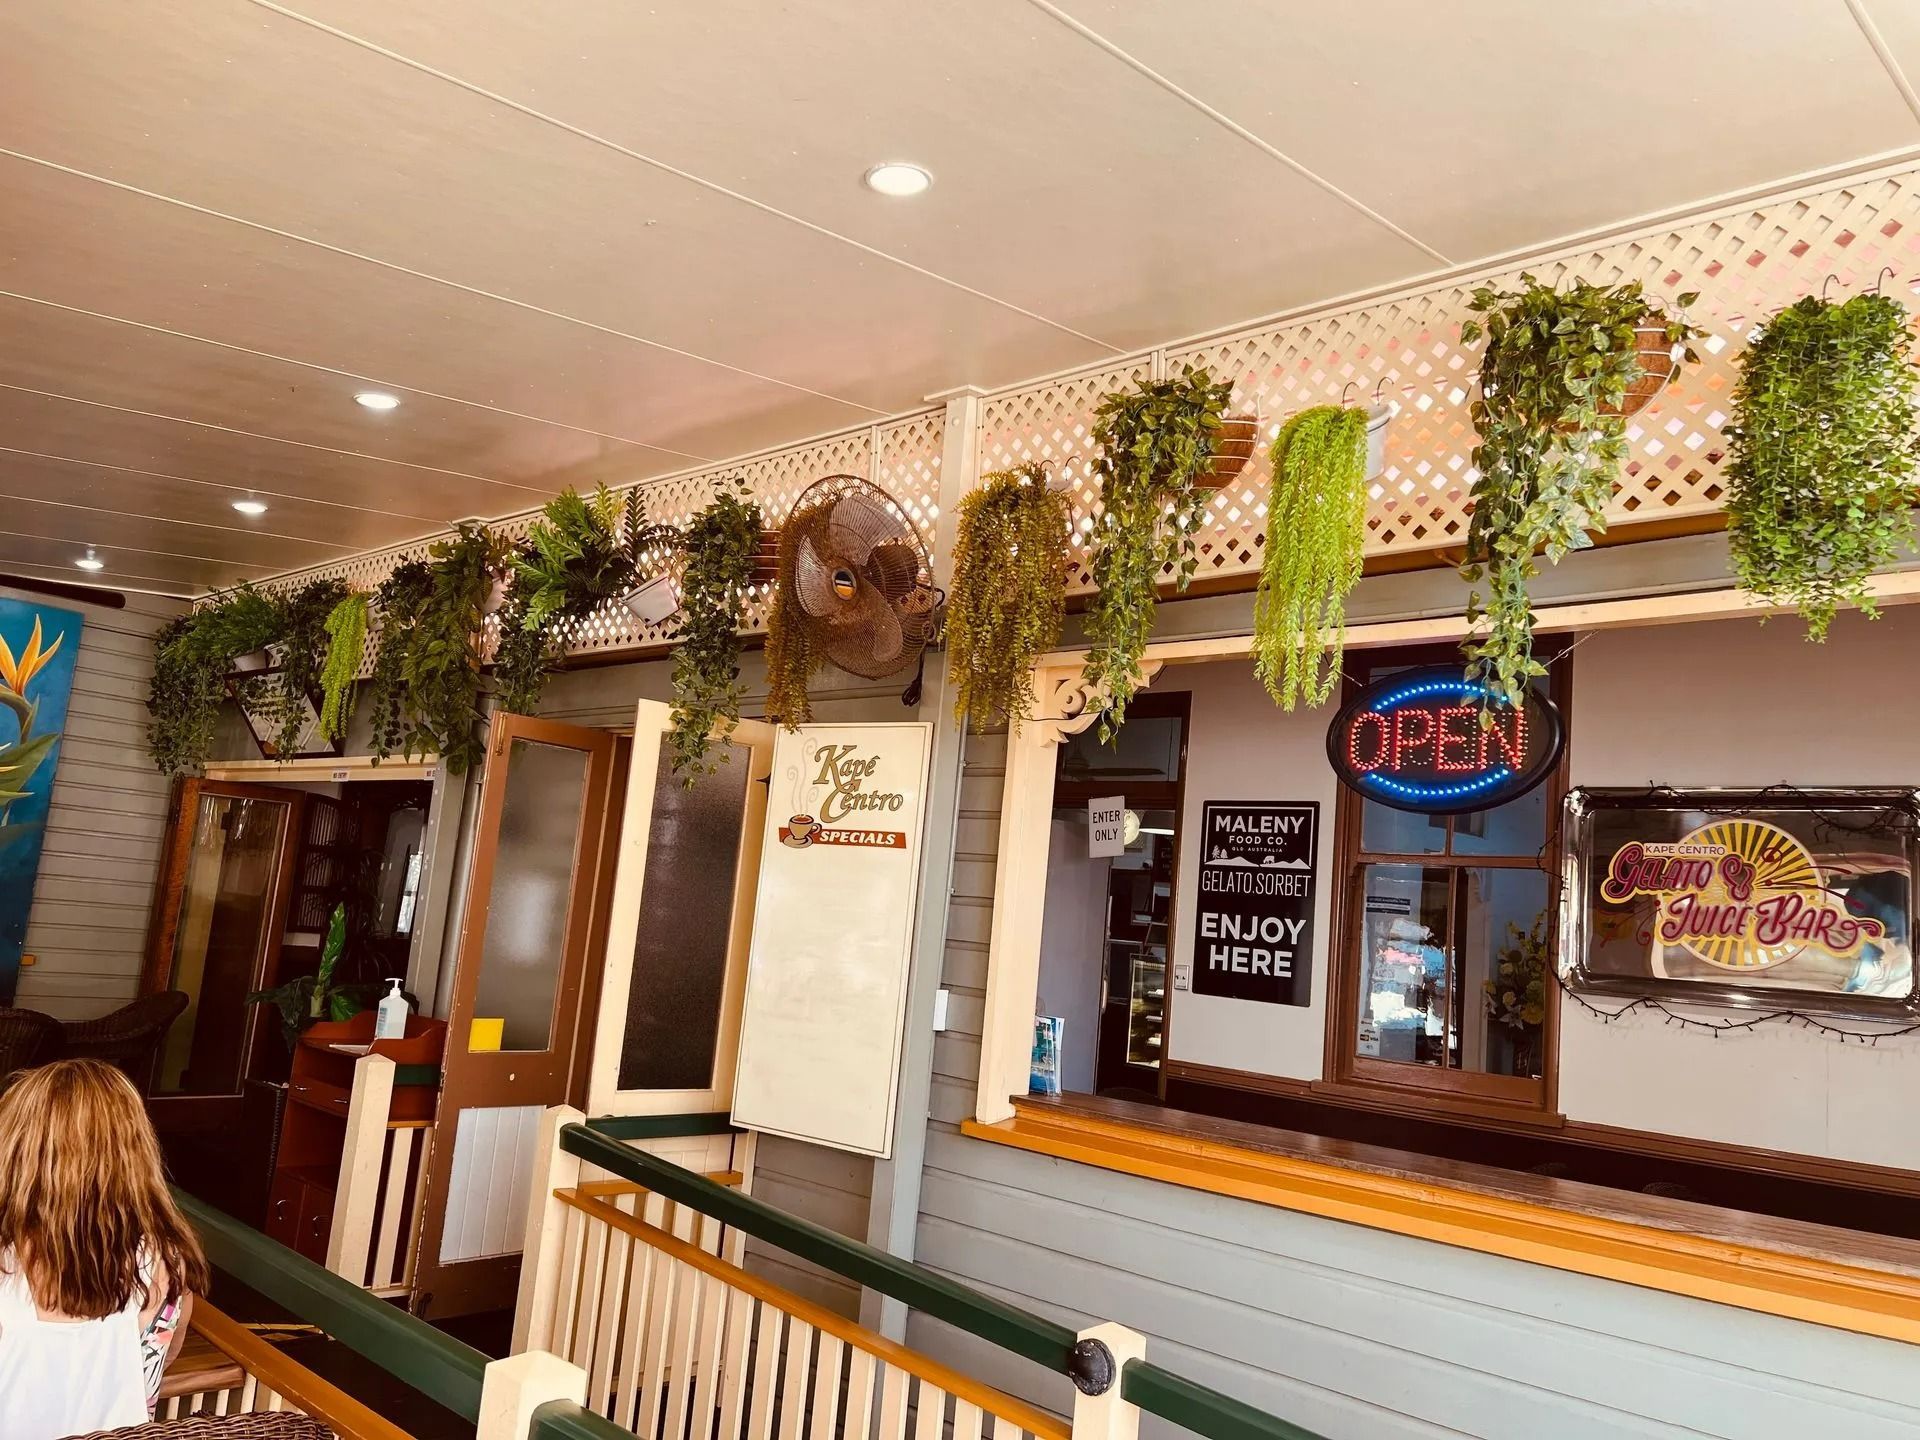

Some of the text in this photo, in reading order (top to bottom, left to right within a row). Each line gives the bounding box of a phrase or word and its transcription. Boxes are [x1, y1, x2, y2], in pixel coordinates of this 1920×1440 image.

[1350, 706, 1527, 771] OPEN
[820, 779, 904, 823] Centro
[1092, 809, 1121, 824] ENTER
[1215, 815, 1305, 834] MALENY
[819, 830, 897, 845] SPECIALS
[1095, 828, 1119, 842] ONLY
[1229, 835, 1287, 845] FOOD CO.
[1645, 845, 1726, 855] KAPE CENTRO
[1201, 912, 1307, 945] ENJOY
[1209, 944, 1293, 978] HERE
